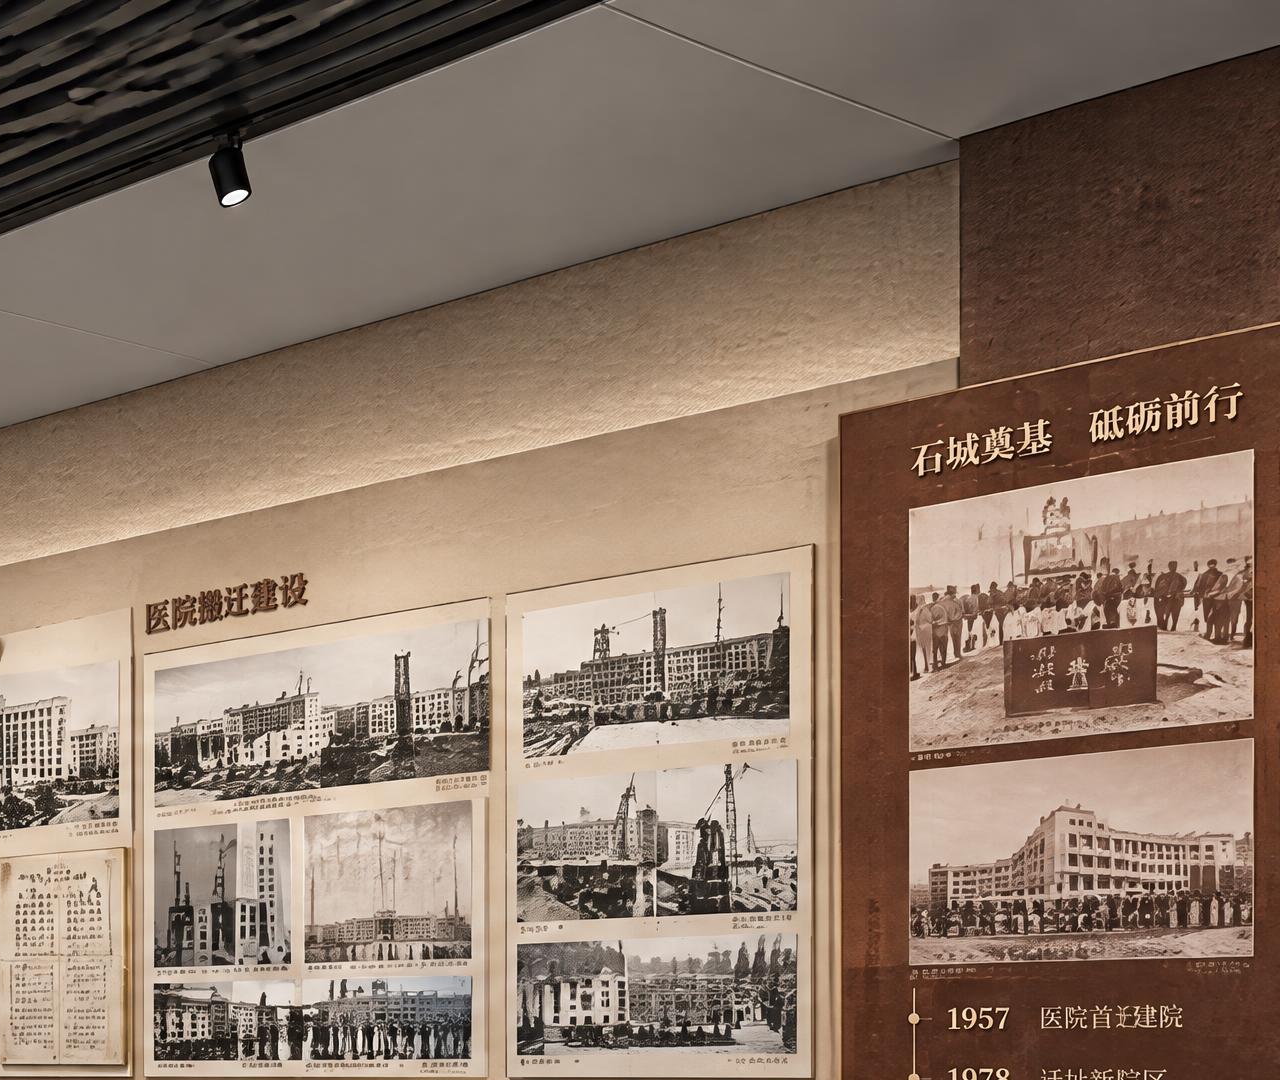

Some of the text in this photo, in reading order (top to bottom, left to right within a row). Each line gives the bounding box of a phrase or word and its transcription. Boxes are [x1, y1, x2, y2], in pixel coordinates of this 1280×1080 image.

[910, 382, 1245, 478] 石城奠基 砥砺前行
[145, 572, 309, 635] 医院搬迁建设
[947, 1007, 1011, 1030] 1957
